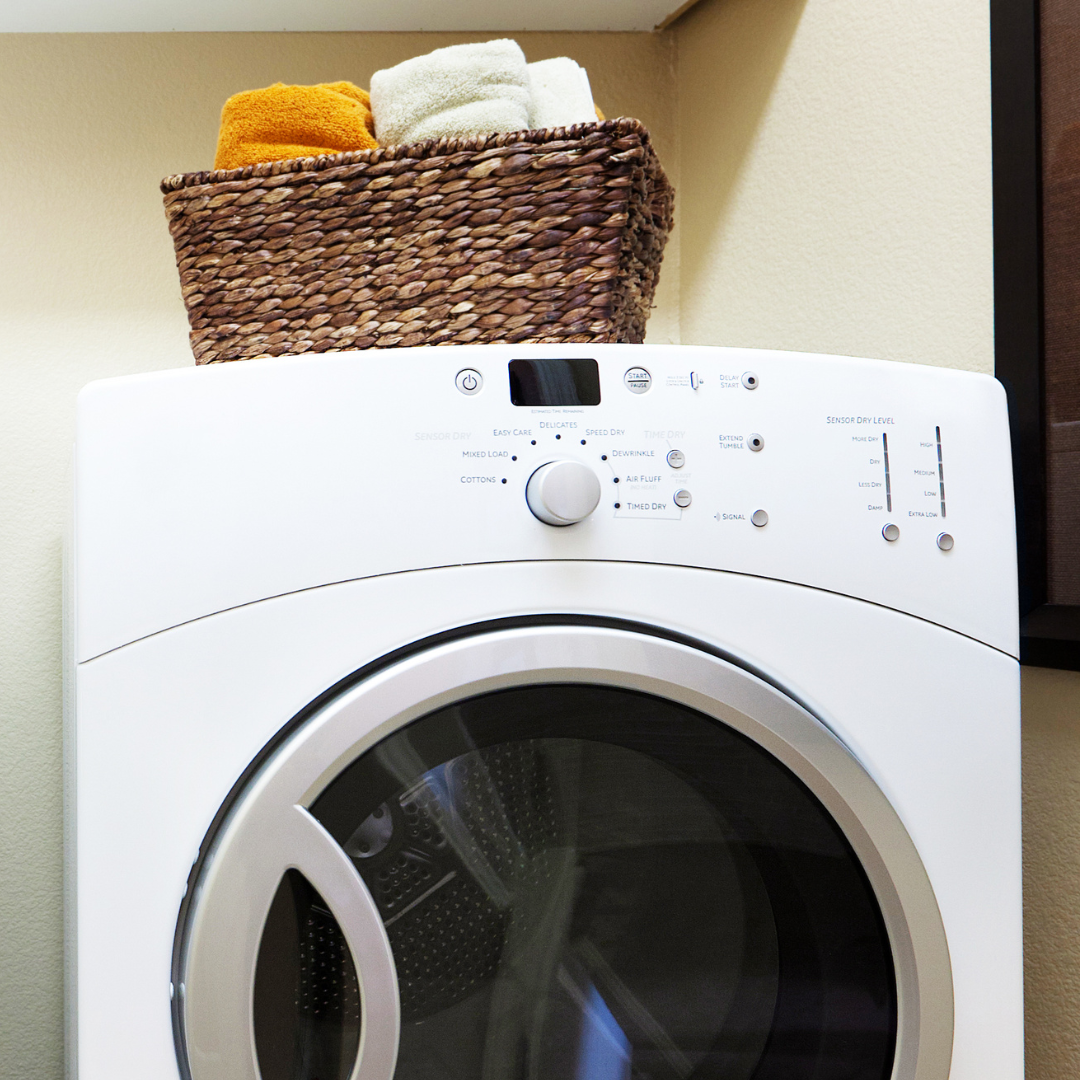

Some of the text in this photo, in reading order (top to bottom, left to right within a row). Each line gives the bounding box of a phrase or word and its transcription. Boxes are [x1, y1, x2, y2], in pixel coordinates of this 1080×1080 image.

[826, 416, 855, 424] SENSOR
[857, 416, 872, 424] DRY
[493, 429, 511, 437] EASY
[586, 428, 608, 436] SPEED
[644, 430, 686, 439] TIME DRY
[415, 432, 472, 441] SENSOR DRY
[719, 442, 744, 450] TUMBLE
[612, 450, 655, 458] DEWRINKLE
[461, 476, 496, 484] COTTONS
[626, 475, 662, 483] AIR FLUFF
[627, 502, 666, 511] TIMED DRY
[722, 513, 745, 521] SIGNAL
